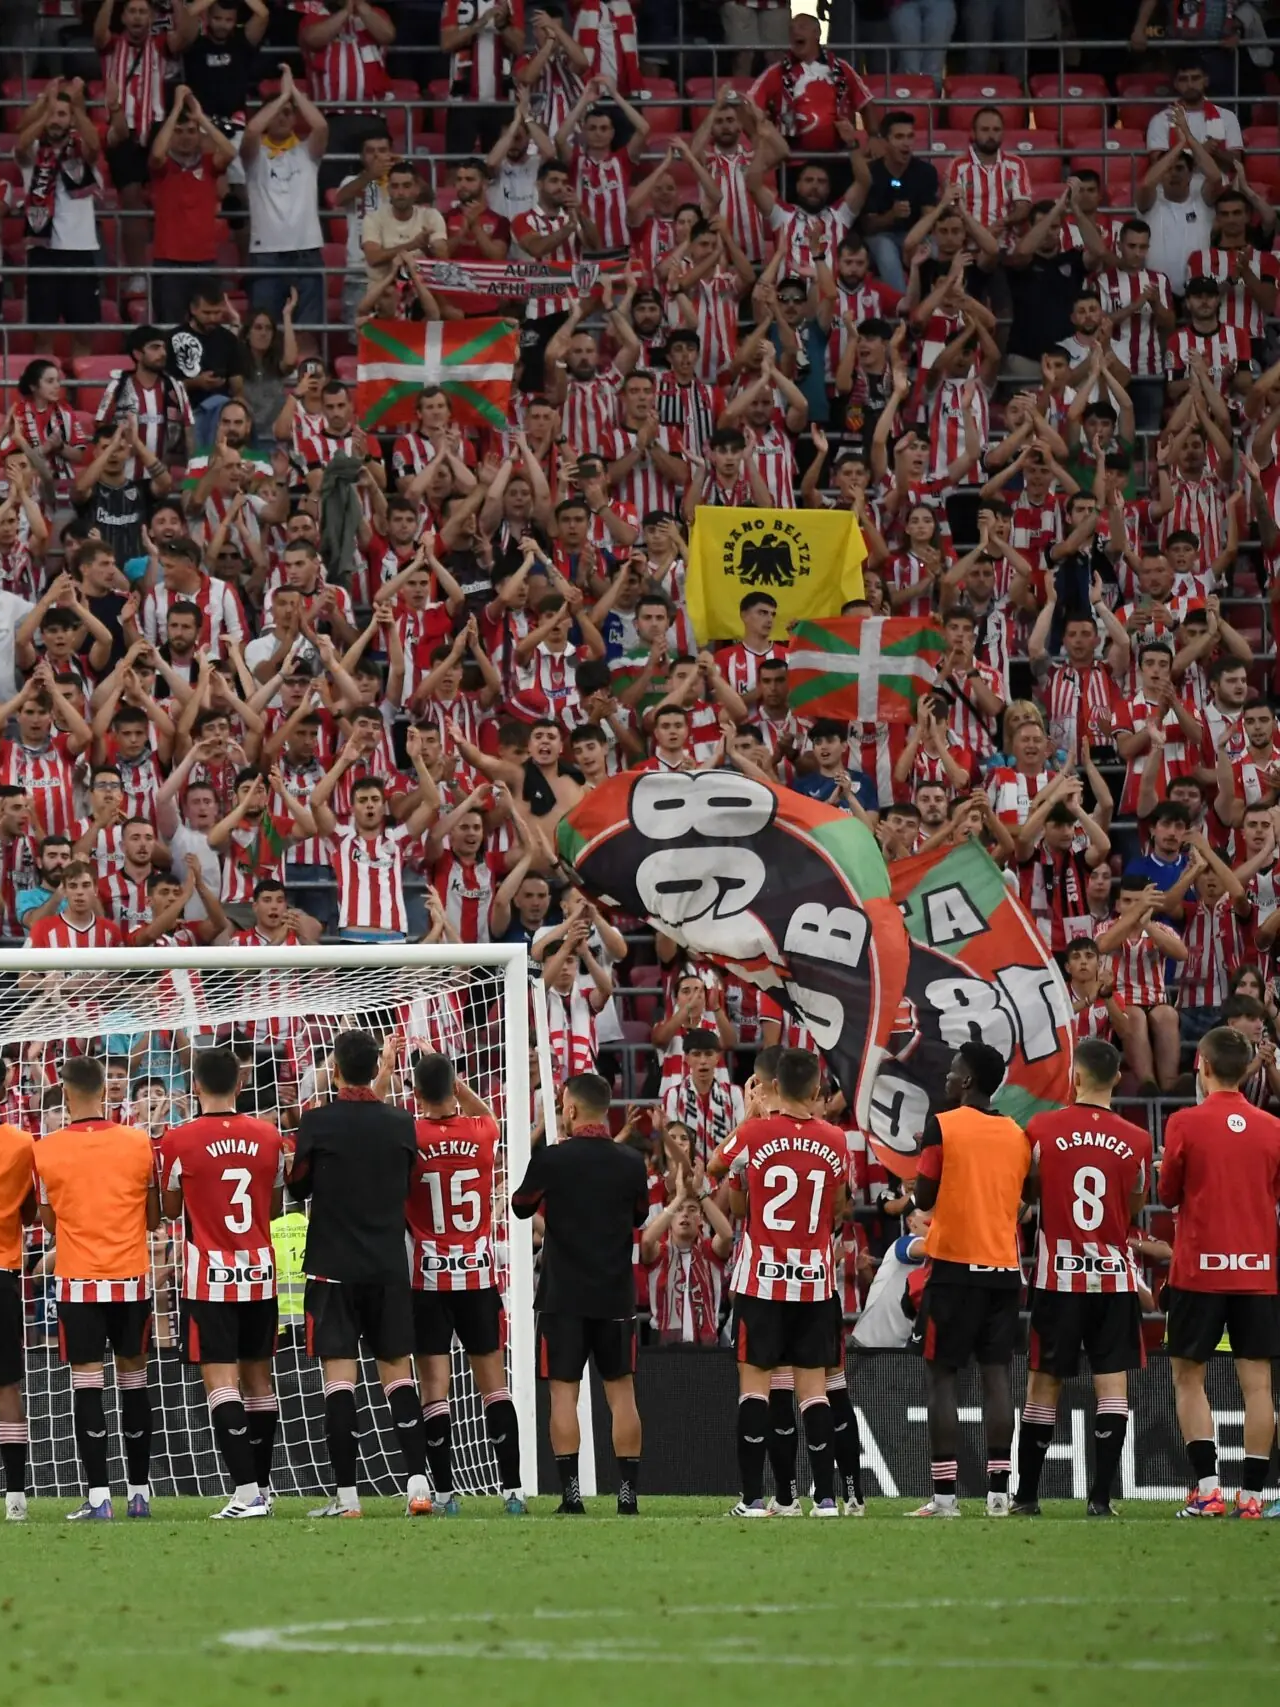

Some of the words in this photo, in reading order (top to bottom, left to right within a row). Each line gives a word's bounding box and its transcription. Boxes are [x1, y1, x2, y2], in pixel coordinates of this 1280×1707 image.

[504, 264, 550, 277] AUPA
[723, 519, 765, 576] ARRANO
[774, 519, 811, 577] BELTZA
[1230, 1119, 1244, 1128] 26
[205, 1139, 260, 1158] VIVIAN
[1055, 1130, 1134, 1161] O.SANCET
[750, 1136, 791, 1170] ANDER
[793, 1136, 842, 1178] HERRERA
[220, 1167, 253, 1235] 3
[420, 1167, 481, 1235] 15
[762, 1164, 827, 1234] 21
[1072, 1165, 1106, 1231] 8
[421, 1253, 490, 1272] DIGI
[757, 1262, 826, 1281] DIGI
[1056, 1255, 1127, 1274] DIGI
[1199, 1253, 1270, 1271] DIGI
[207, 1265, 272, 1284] DIGI
